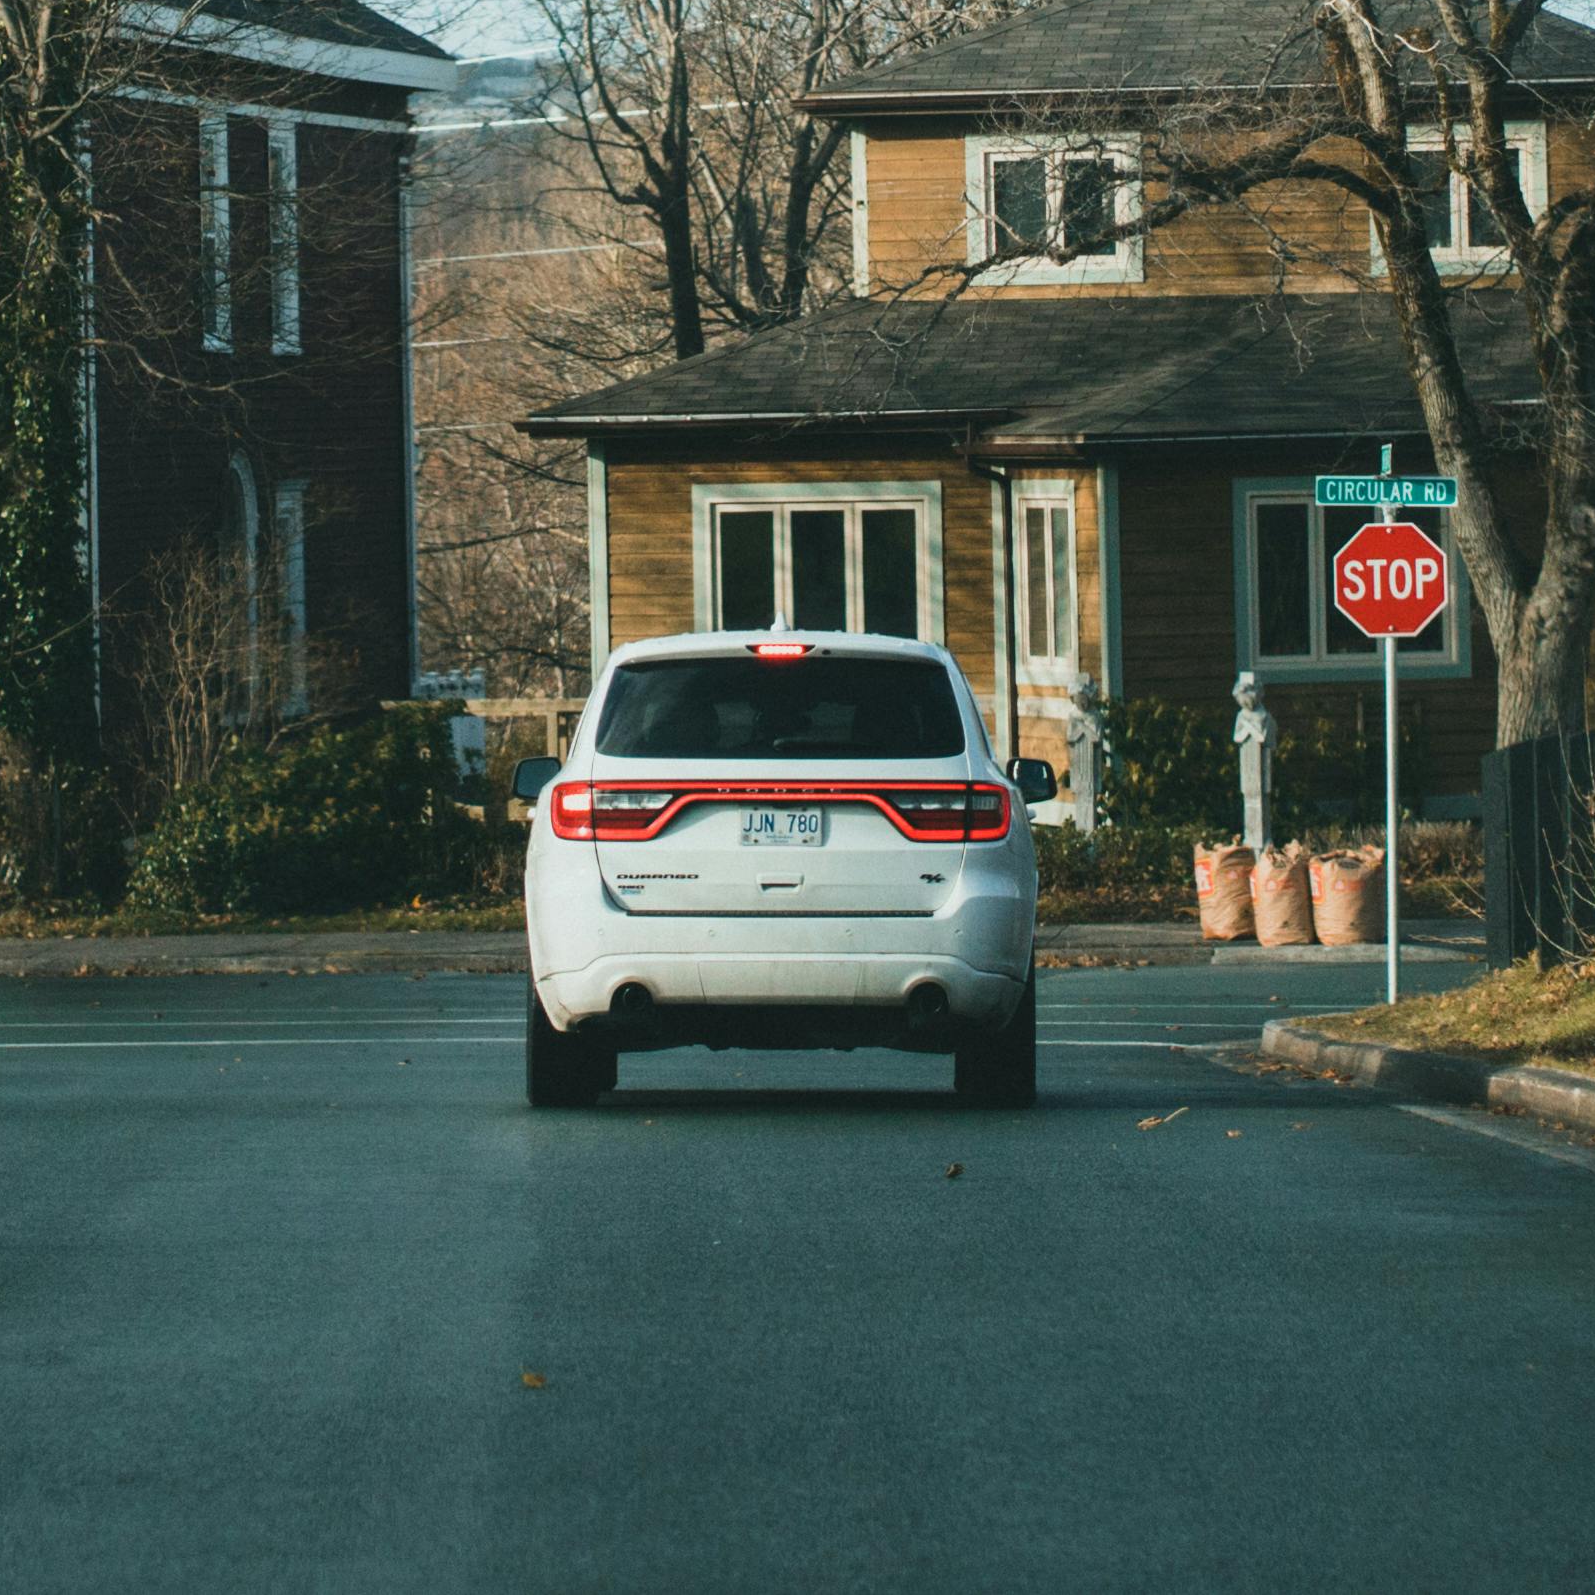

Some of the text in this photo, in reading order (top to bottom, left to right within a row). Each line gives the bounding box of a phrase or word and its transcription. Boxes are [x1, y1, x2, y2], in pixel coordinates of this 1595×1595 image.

[1325, 481, 1447, 502] CIRCULAR RD
[1342, 558, 1439, 601] STOP
[743, 813, 818, 833] JJN 780
